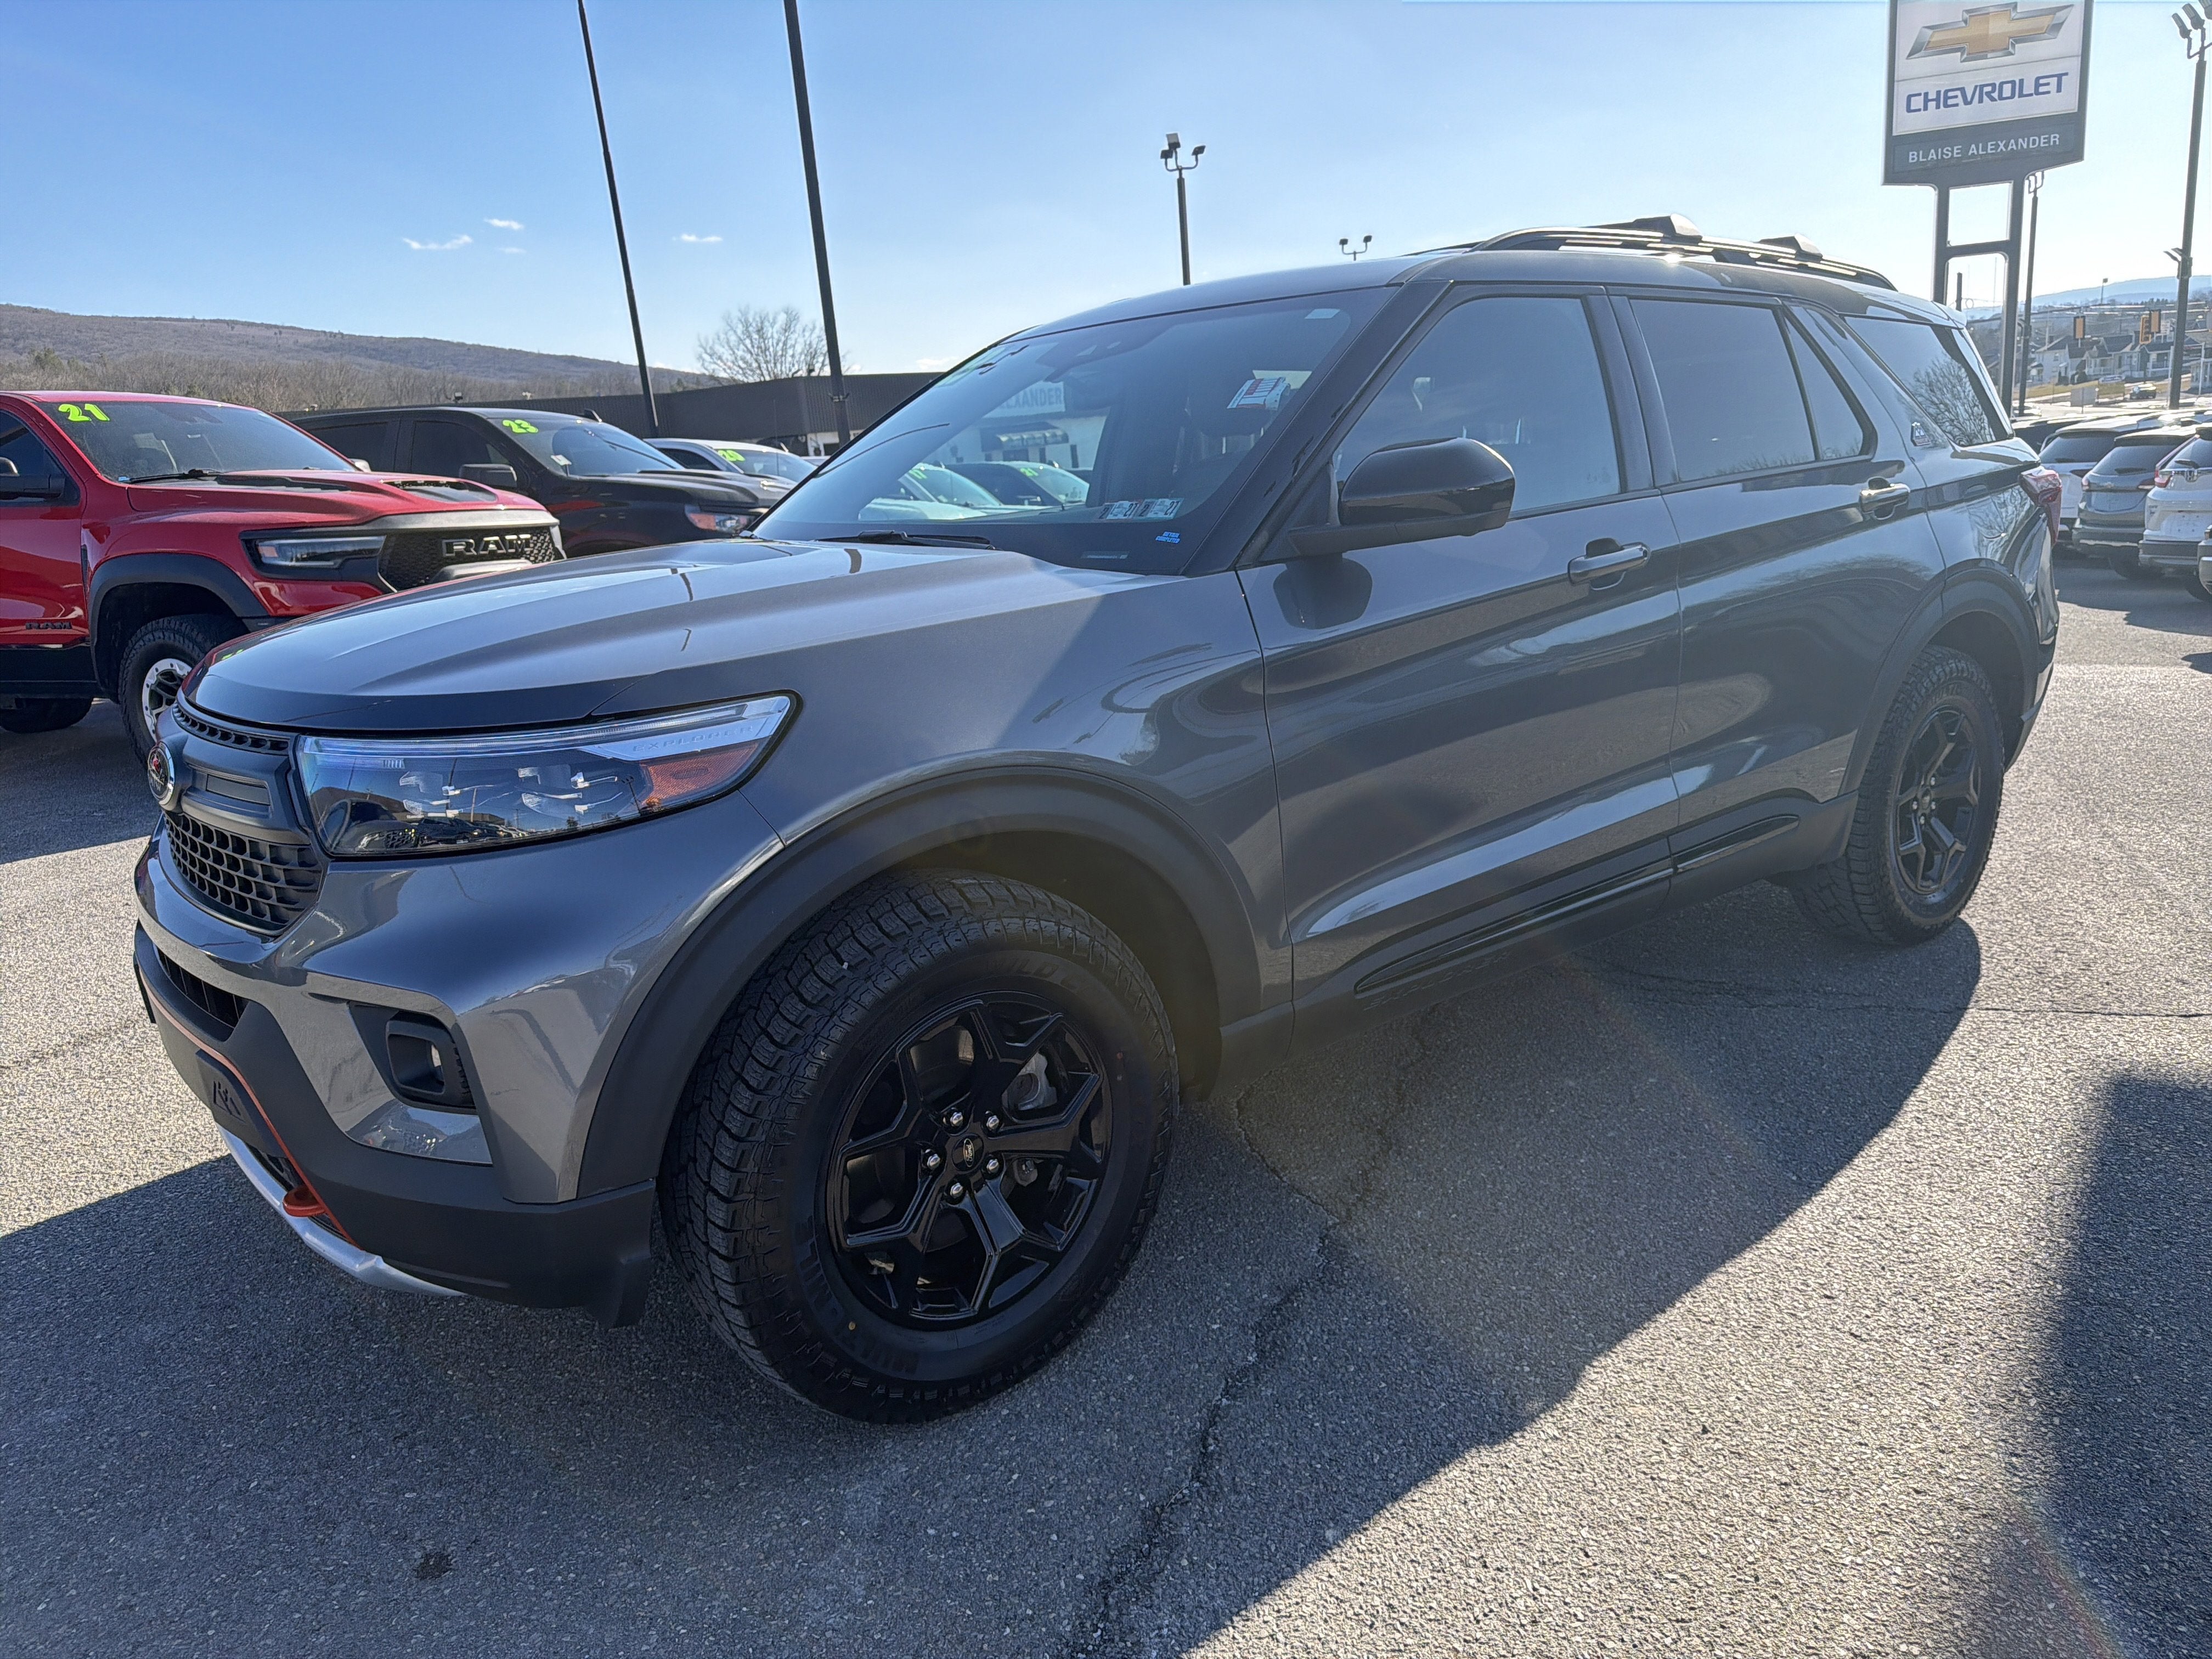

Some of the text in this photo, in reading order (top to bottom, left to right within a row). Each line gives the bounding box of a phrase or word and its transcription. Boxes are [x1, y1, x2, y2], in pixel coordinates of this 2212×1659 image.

[1906, 72, 2068, 113] CHEVROLET
[1908, 133, 2060, 163] BLAISE ALEXANDER
[59, 403, 110, 421] 21
[503, 419, 538, 433] 23
[1139, 500, 1180, 517] 2 27
[442, 534, 532, 557] RAM
[26, 621, 72, 630] RAM
[633, 725, 753, 752] EXPLORER
